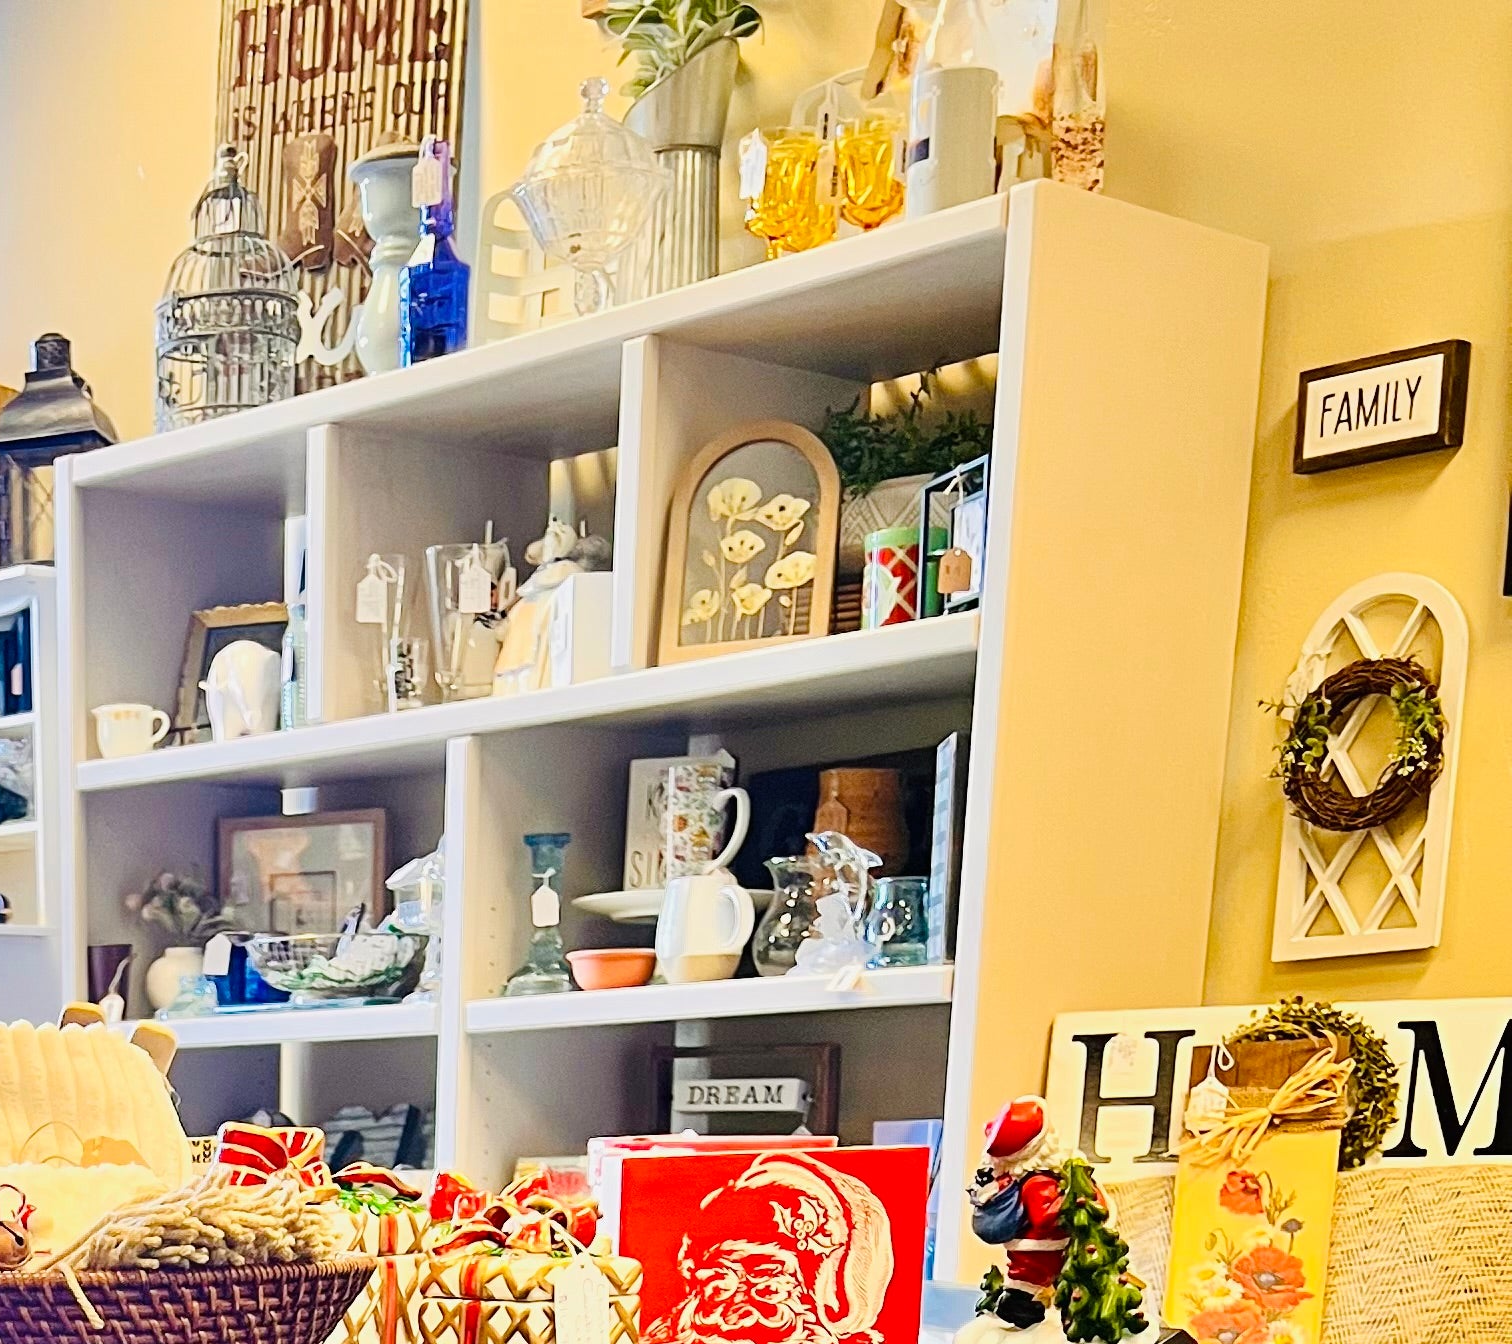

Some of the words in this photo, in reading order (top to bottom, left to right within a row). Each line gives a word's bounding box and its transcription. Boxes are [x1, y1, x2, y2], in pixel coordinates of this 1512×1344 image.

[232, 0, 448, 88] HOME
[1319, 375, 1422, 438] FAMILY
[685, 1083, 785, 1107] DREAM
